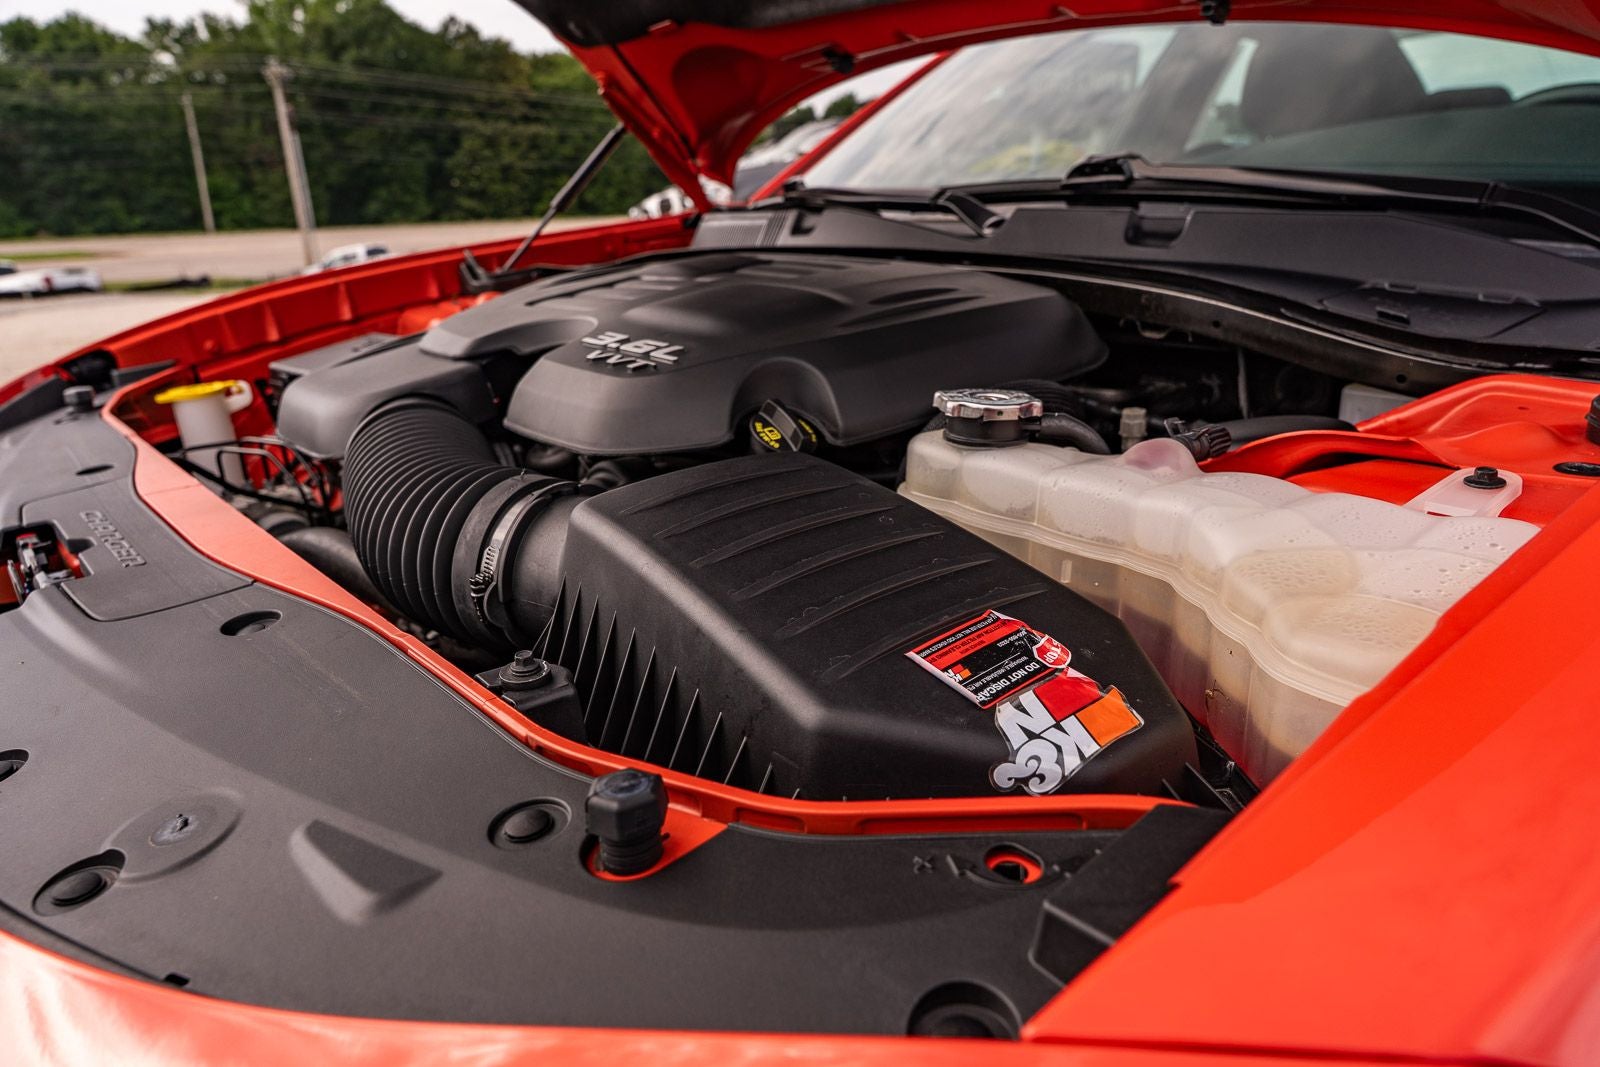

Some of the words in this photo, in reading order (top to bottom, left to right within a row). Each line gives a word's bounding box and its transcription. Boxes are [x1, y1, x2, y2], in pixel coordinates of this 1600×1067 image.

[581, 331, 685, 364] 3.6L
[585, 349, 657, 369] VVT
[79, 510, 147, 568] CHARGER
[1005, 668, 1028, 682] NOT
[1023, 661, 1040, 672] DO
[993, 690, 1100, 793] K&N
